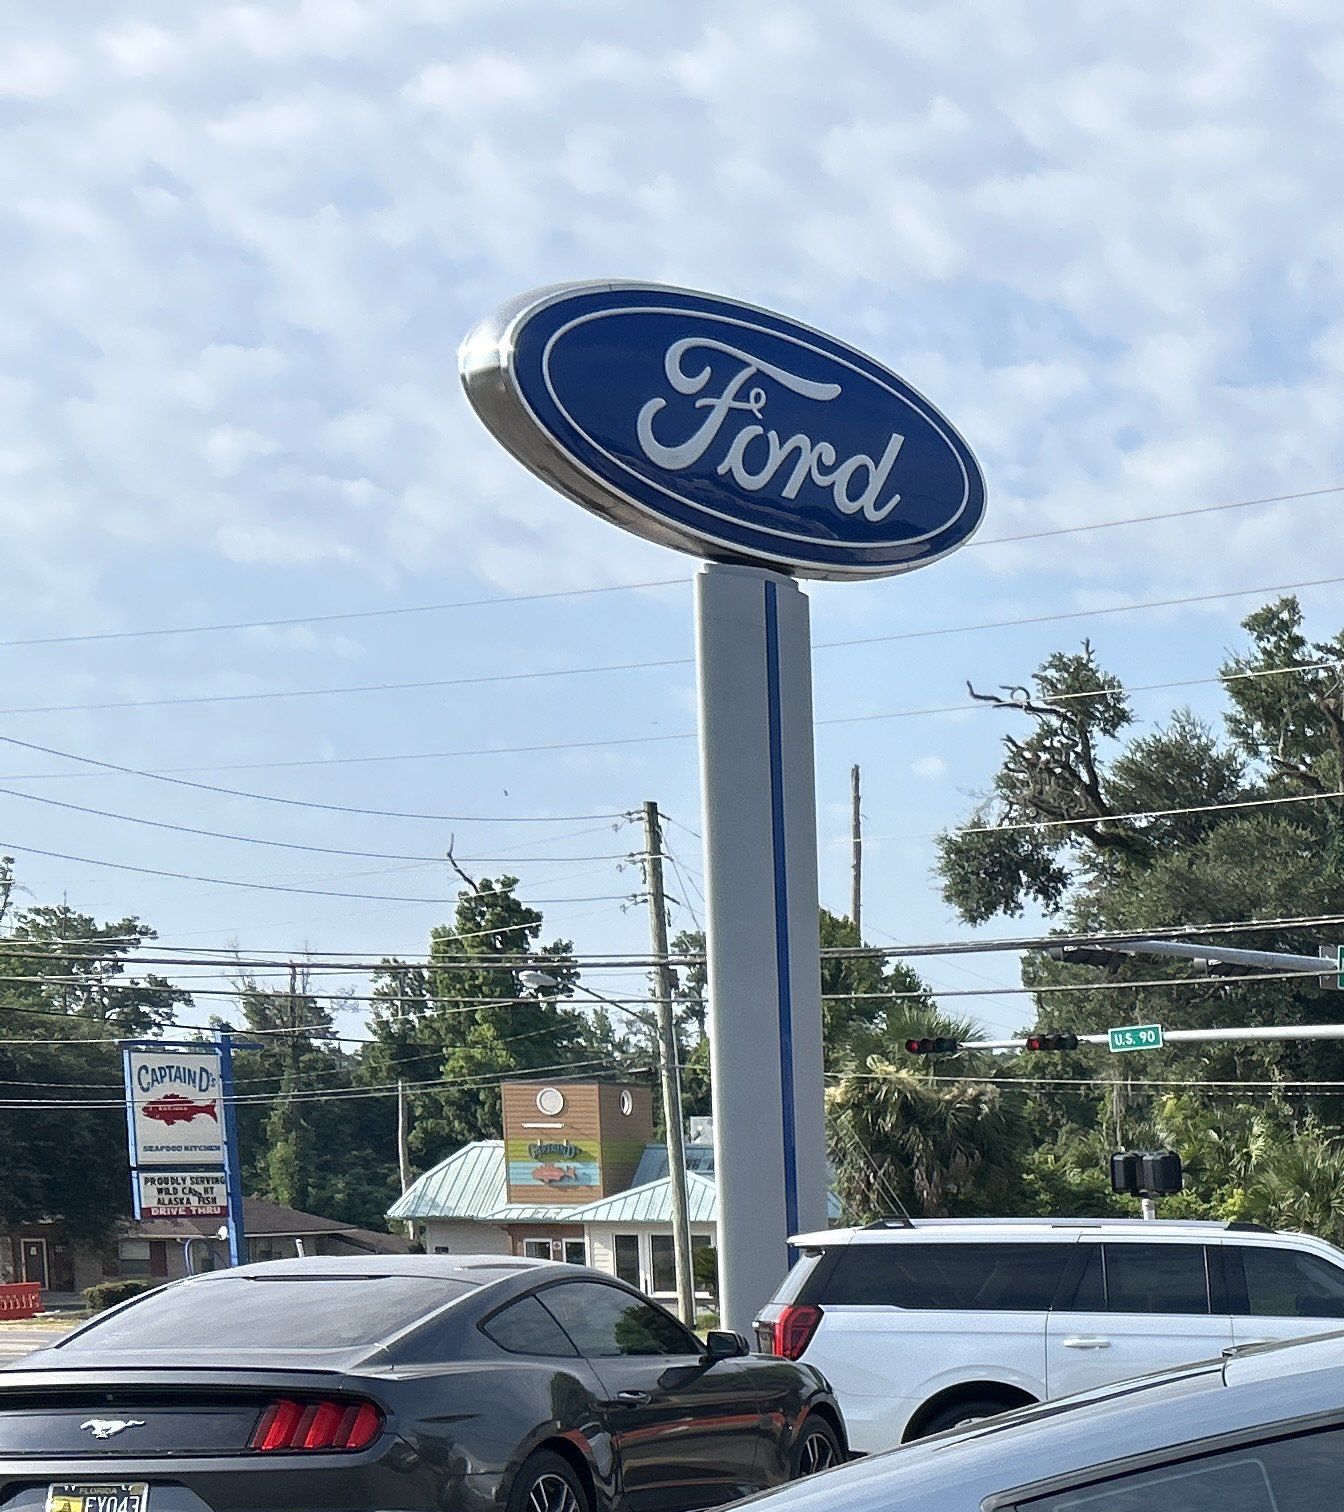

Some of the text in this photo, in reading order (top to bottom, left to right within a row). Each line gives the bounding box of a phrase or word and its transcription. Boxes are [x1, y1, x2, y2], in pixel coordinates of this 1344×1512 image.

[637, 337, 904, 522] Ford
[1114, 1030, 1156, 1046] U.S. 90
[138, 1064, 197, 1093] CAPTAIN
[144, 1176, 226, 1186] PROUDLY SERVING
[156, 1186, 179, 1196] WILD
[157, 1196, 217, 1206] ALASKA FISH
[150, 1206, 221, 1216] DRIVE THRU
[79, 1487, 118, 1495] FLORIDA
